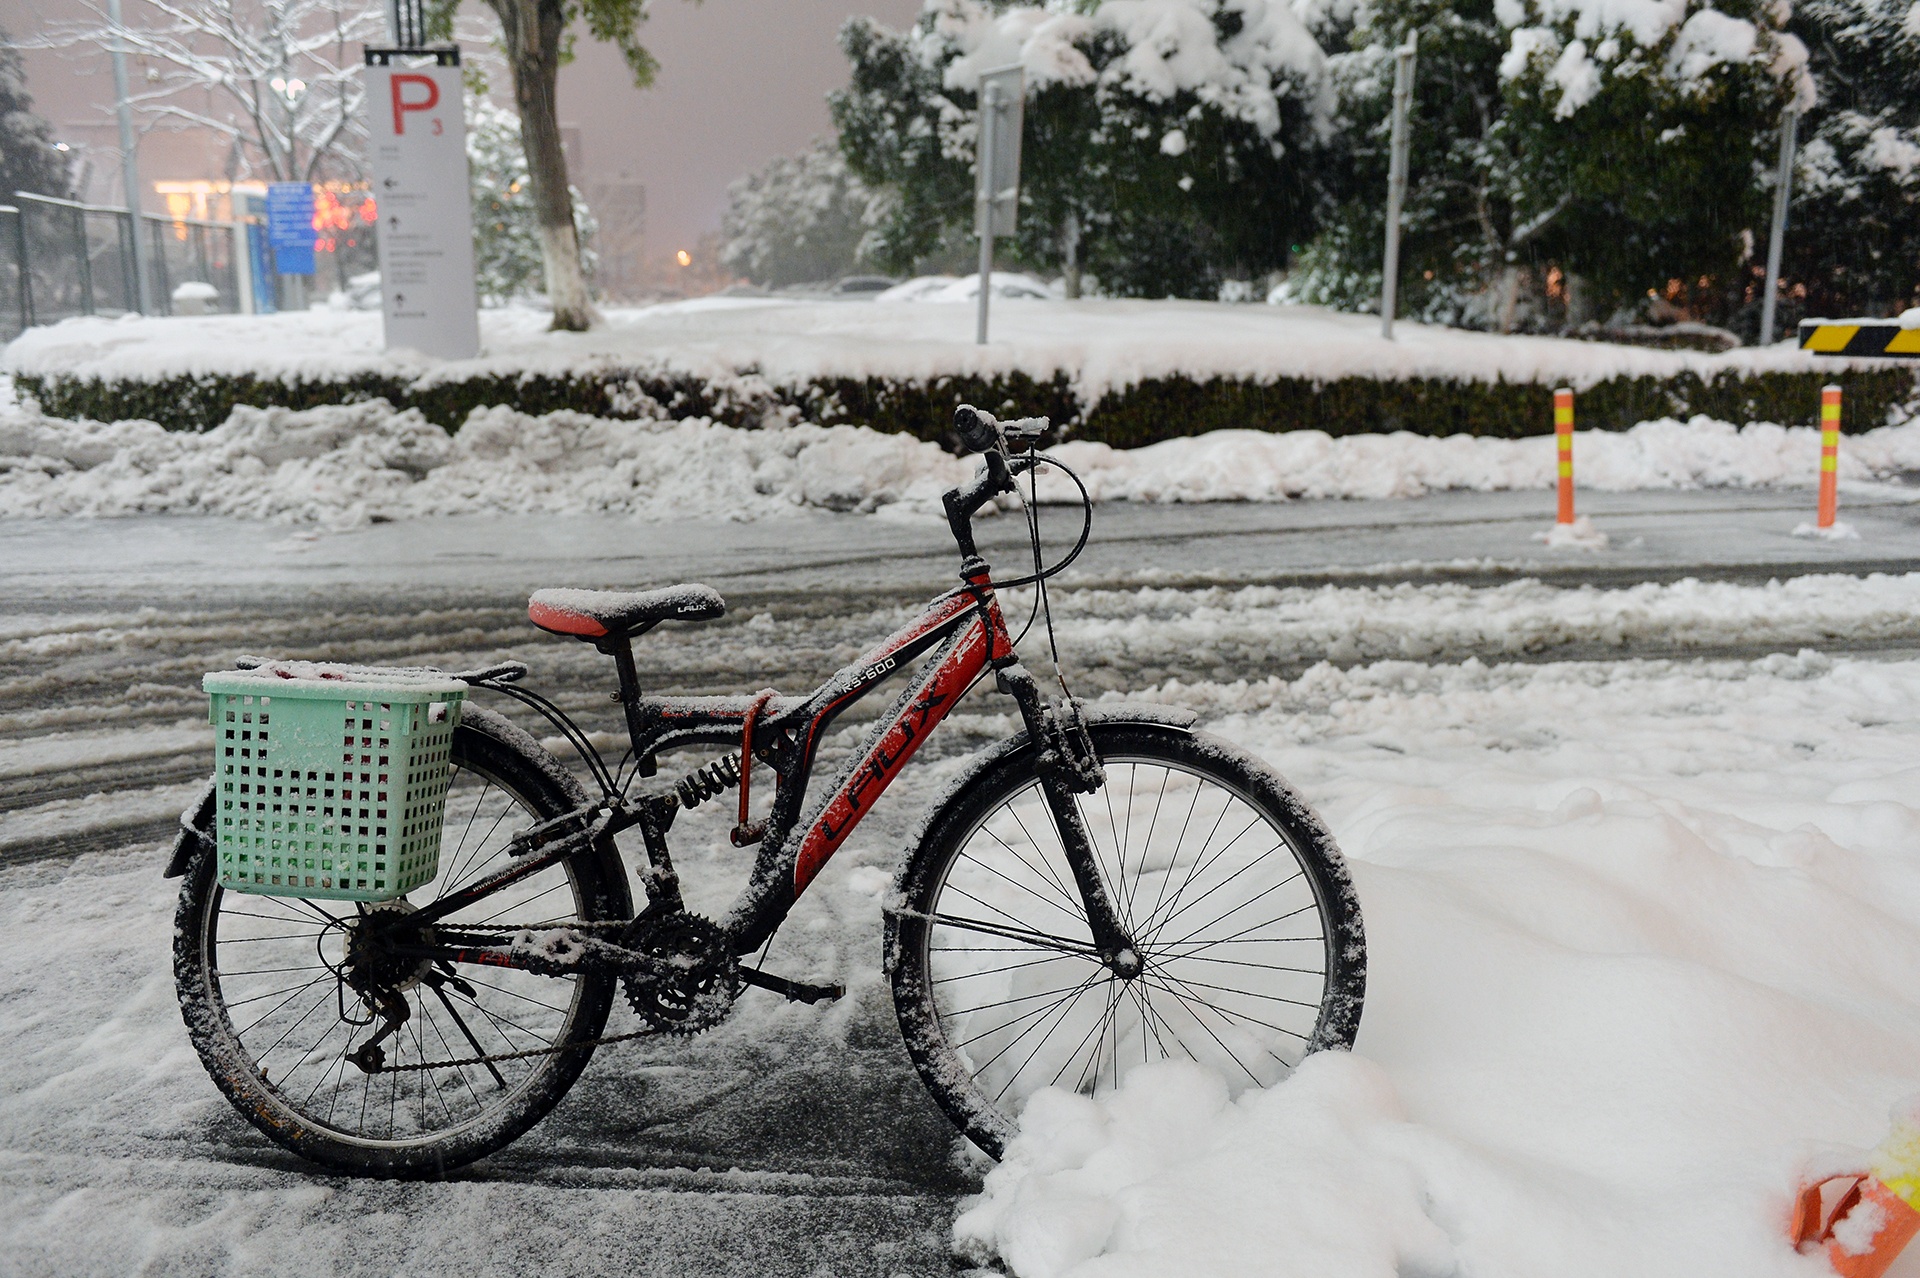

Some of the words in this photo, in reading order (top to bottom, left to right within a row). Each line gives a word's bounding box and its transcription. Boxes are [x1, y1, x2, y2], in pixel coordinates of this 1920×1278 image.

[677, 604, 707, 613] LAUX
[840, 657, 896, 693] RS-600
[820, 679, 948, 842] LAUX
